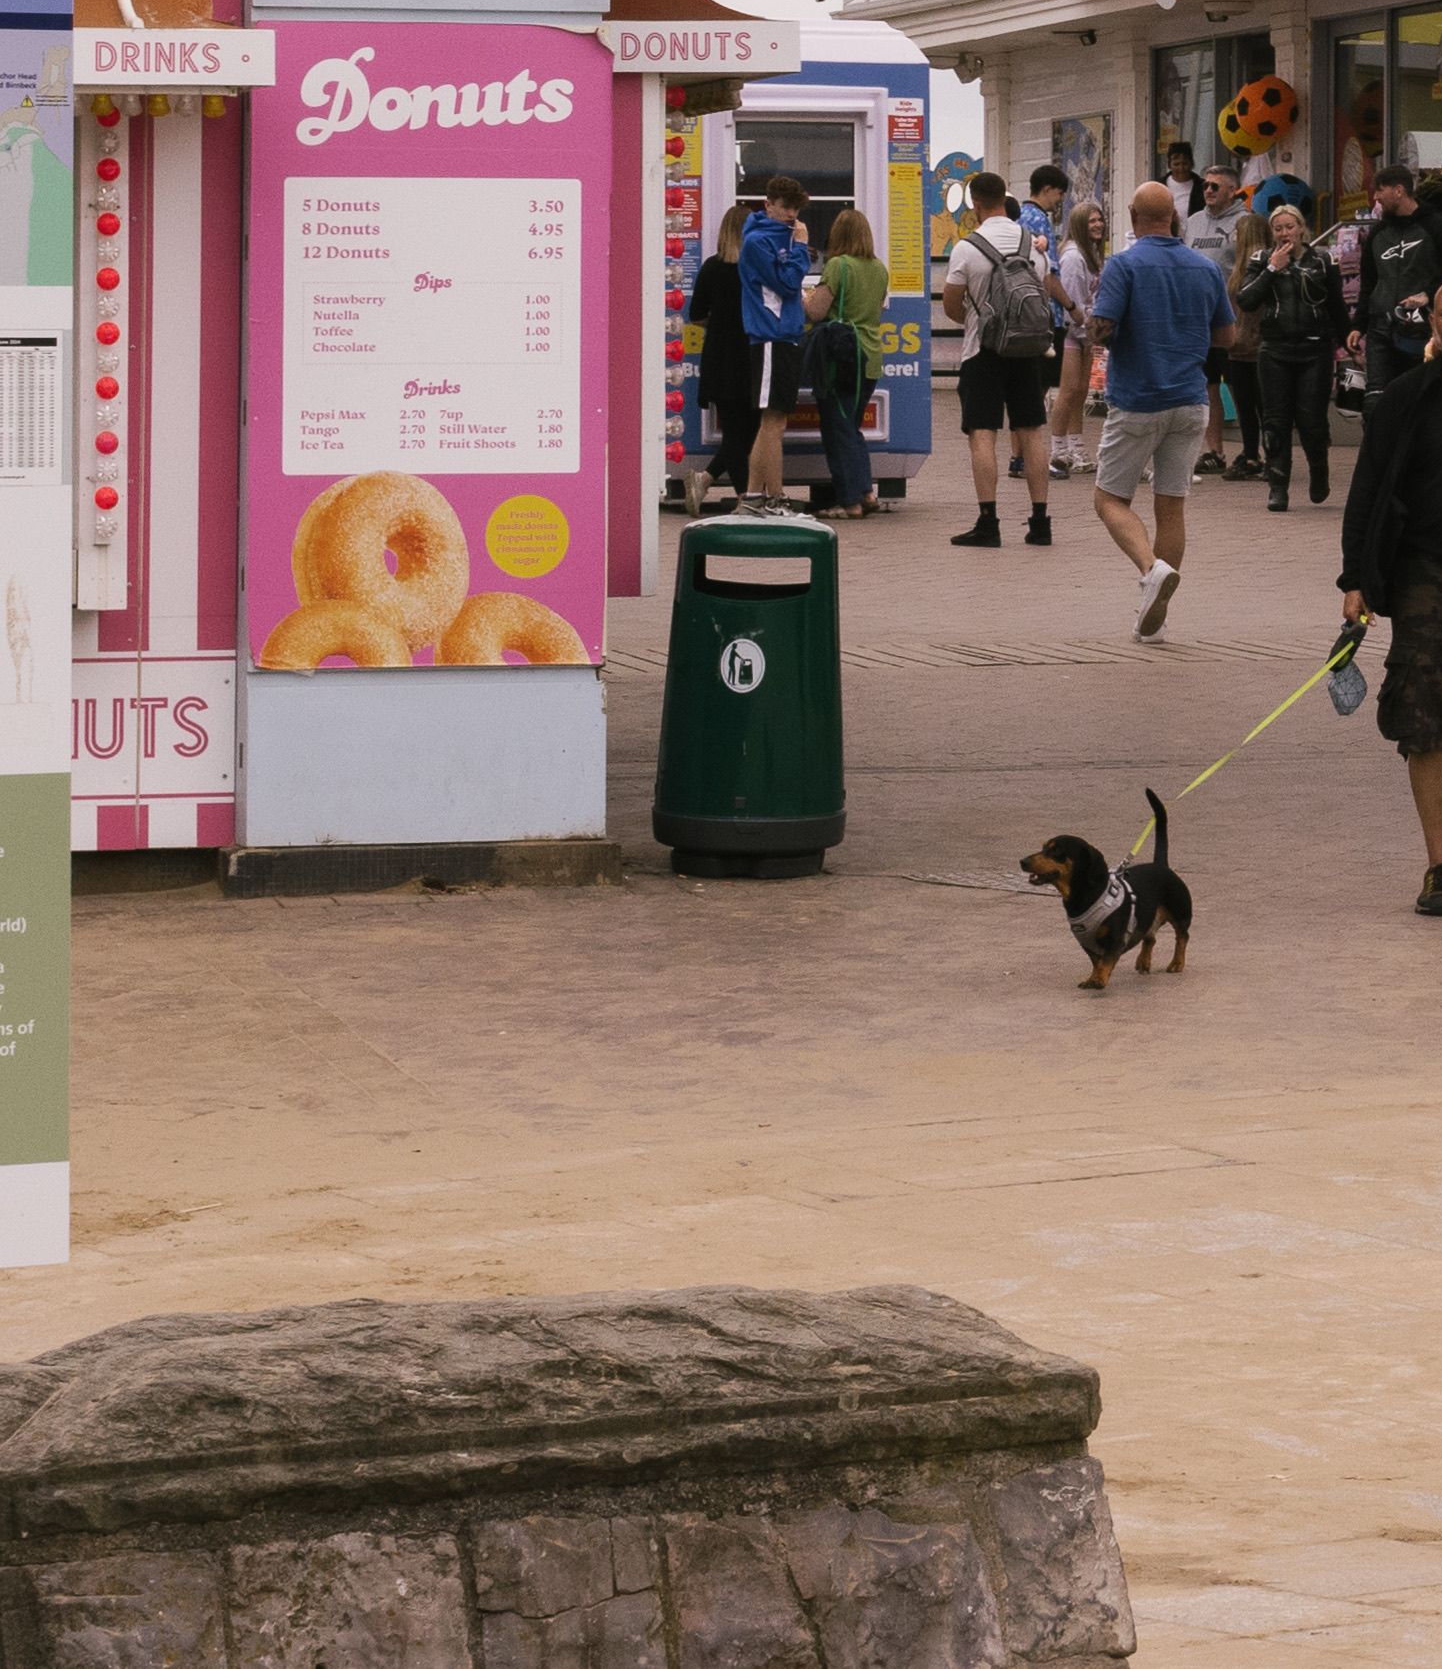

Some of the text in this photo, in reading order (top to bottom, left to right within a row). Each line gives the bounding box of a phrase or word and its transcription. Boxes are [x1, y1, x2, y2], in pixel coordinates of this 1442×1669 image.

[620, 32, 753, 62] DONUTS
[95, 43, 220, 74] DRINKS
[297, 46, 573, 147] Donuts
[302, 199, 564, 213] 5 Donuts 3.50
[302, 222, 563, 236] 8 Donuts 4.95
[1191, 237, 1224, 248] PUMA
[303, 245, 563, 259] 12 Donuts 6.95
[413, 272, 452, 293] Dips
[313, 295, 550, 306] Strawberry 1.00
[313, 311, 550, 321] Nutella 1.00
[313, 327, 550, 337] Toffee 1.00
[312, 343, 550, 353] Chocolate 1.00
[403, 379, 461, 399] Drinks
[72, 696, 209, 759] UTS
